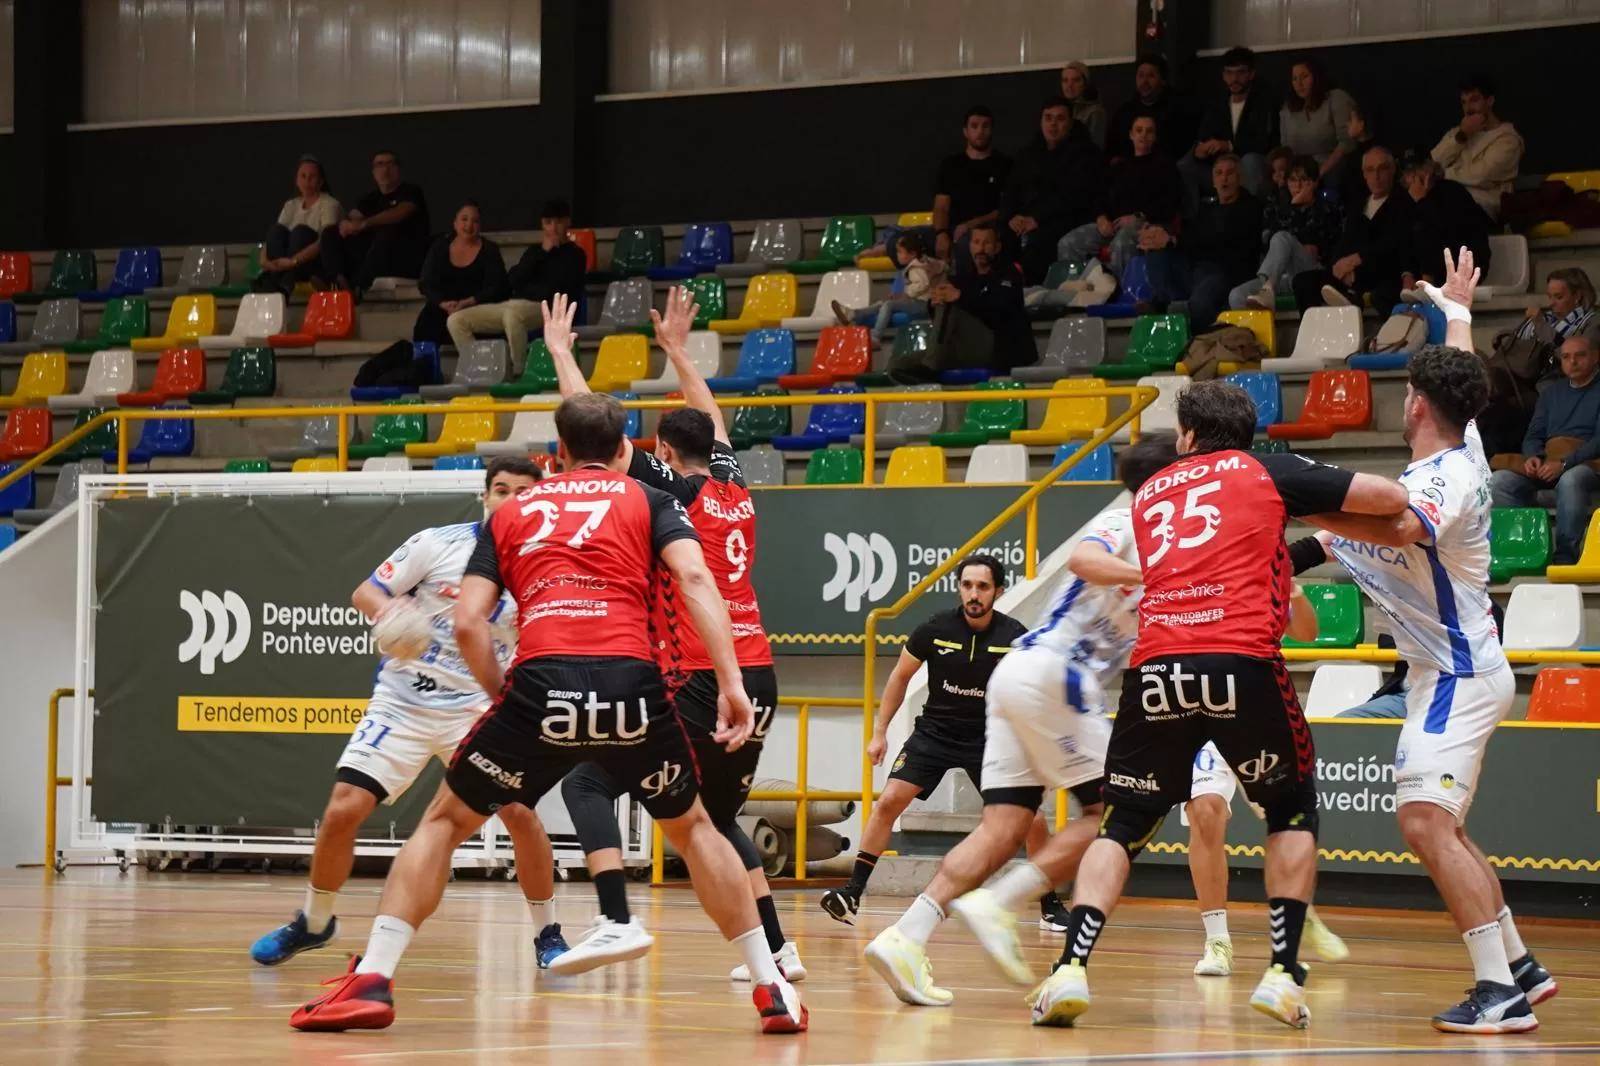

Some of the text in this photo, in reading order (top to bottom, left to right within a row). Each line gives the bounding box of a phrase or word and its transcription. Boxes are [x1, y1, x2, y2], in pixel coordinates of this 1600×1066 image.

[516, 480, 626, 501] CASANOVA
[1135, 456, 1248, 510] PEDRO M.
[518, 499, 612, 556] 27
[1143, 479, 1222, 568] 35
[726, 528, 748, 583] 9
[1170, 608, 1224, 621] AUTOBAFER
[1141, 664, 1167, 673] GRUPO
[547, 690, 583, 699] GRUPO
[943, 680, 984, 697] helvetia
[1141, 662, 1236, 713] atu
[194, 702, 298, 723] Tendemos
[541, 691, 649, 739] atu
[350, 719, 392, 751] 31
